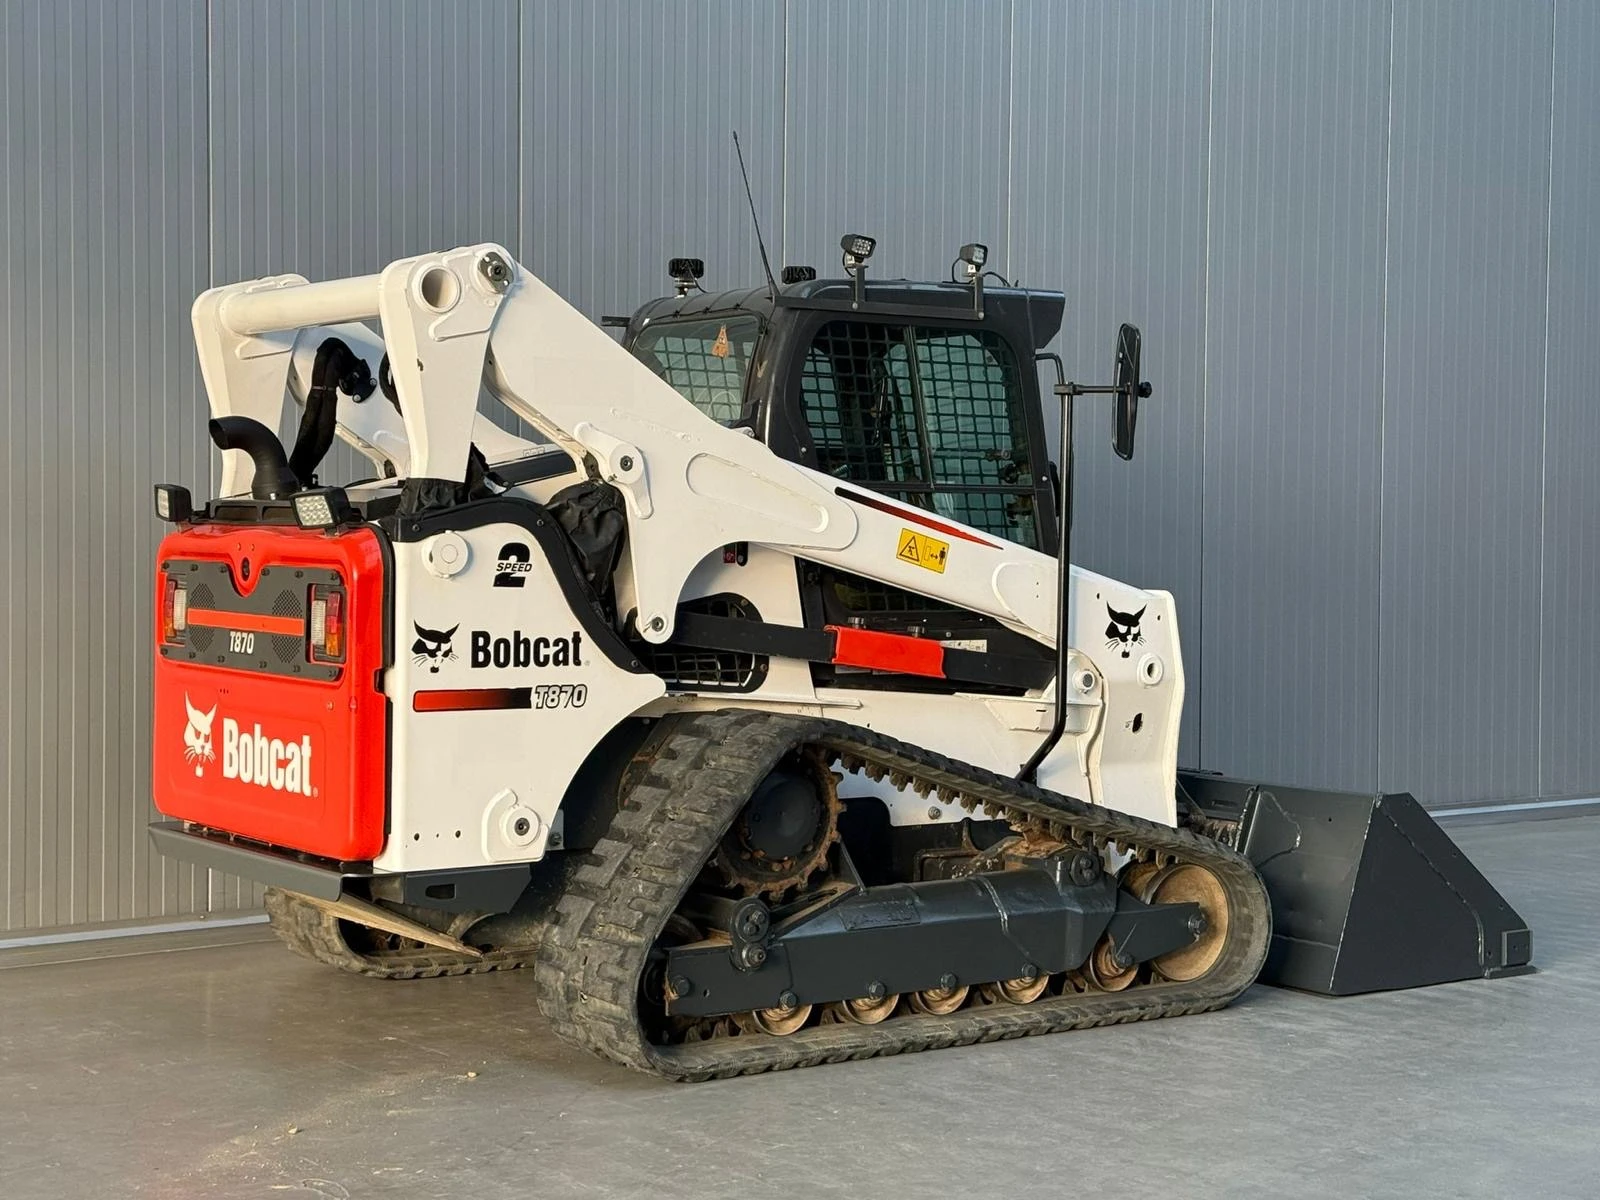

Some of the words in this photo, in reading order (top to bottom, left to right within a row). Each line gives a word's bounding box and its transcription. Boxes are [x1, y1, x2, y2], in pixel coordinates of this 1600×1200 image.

[493, 542, 531, 588] 2
[496, 562, 533, 573] SPEED
[229, 631, 255, 655] T870
[471, 630, 582, 667] Bobcat
[533, 684, 587, 708] T870
[222, 717, 312, 798] Bobcat
